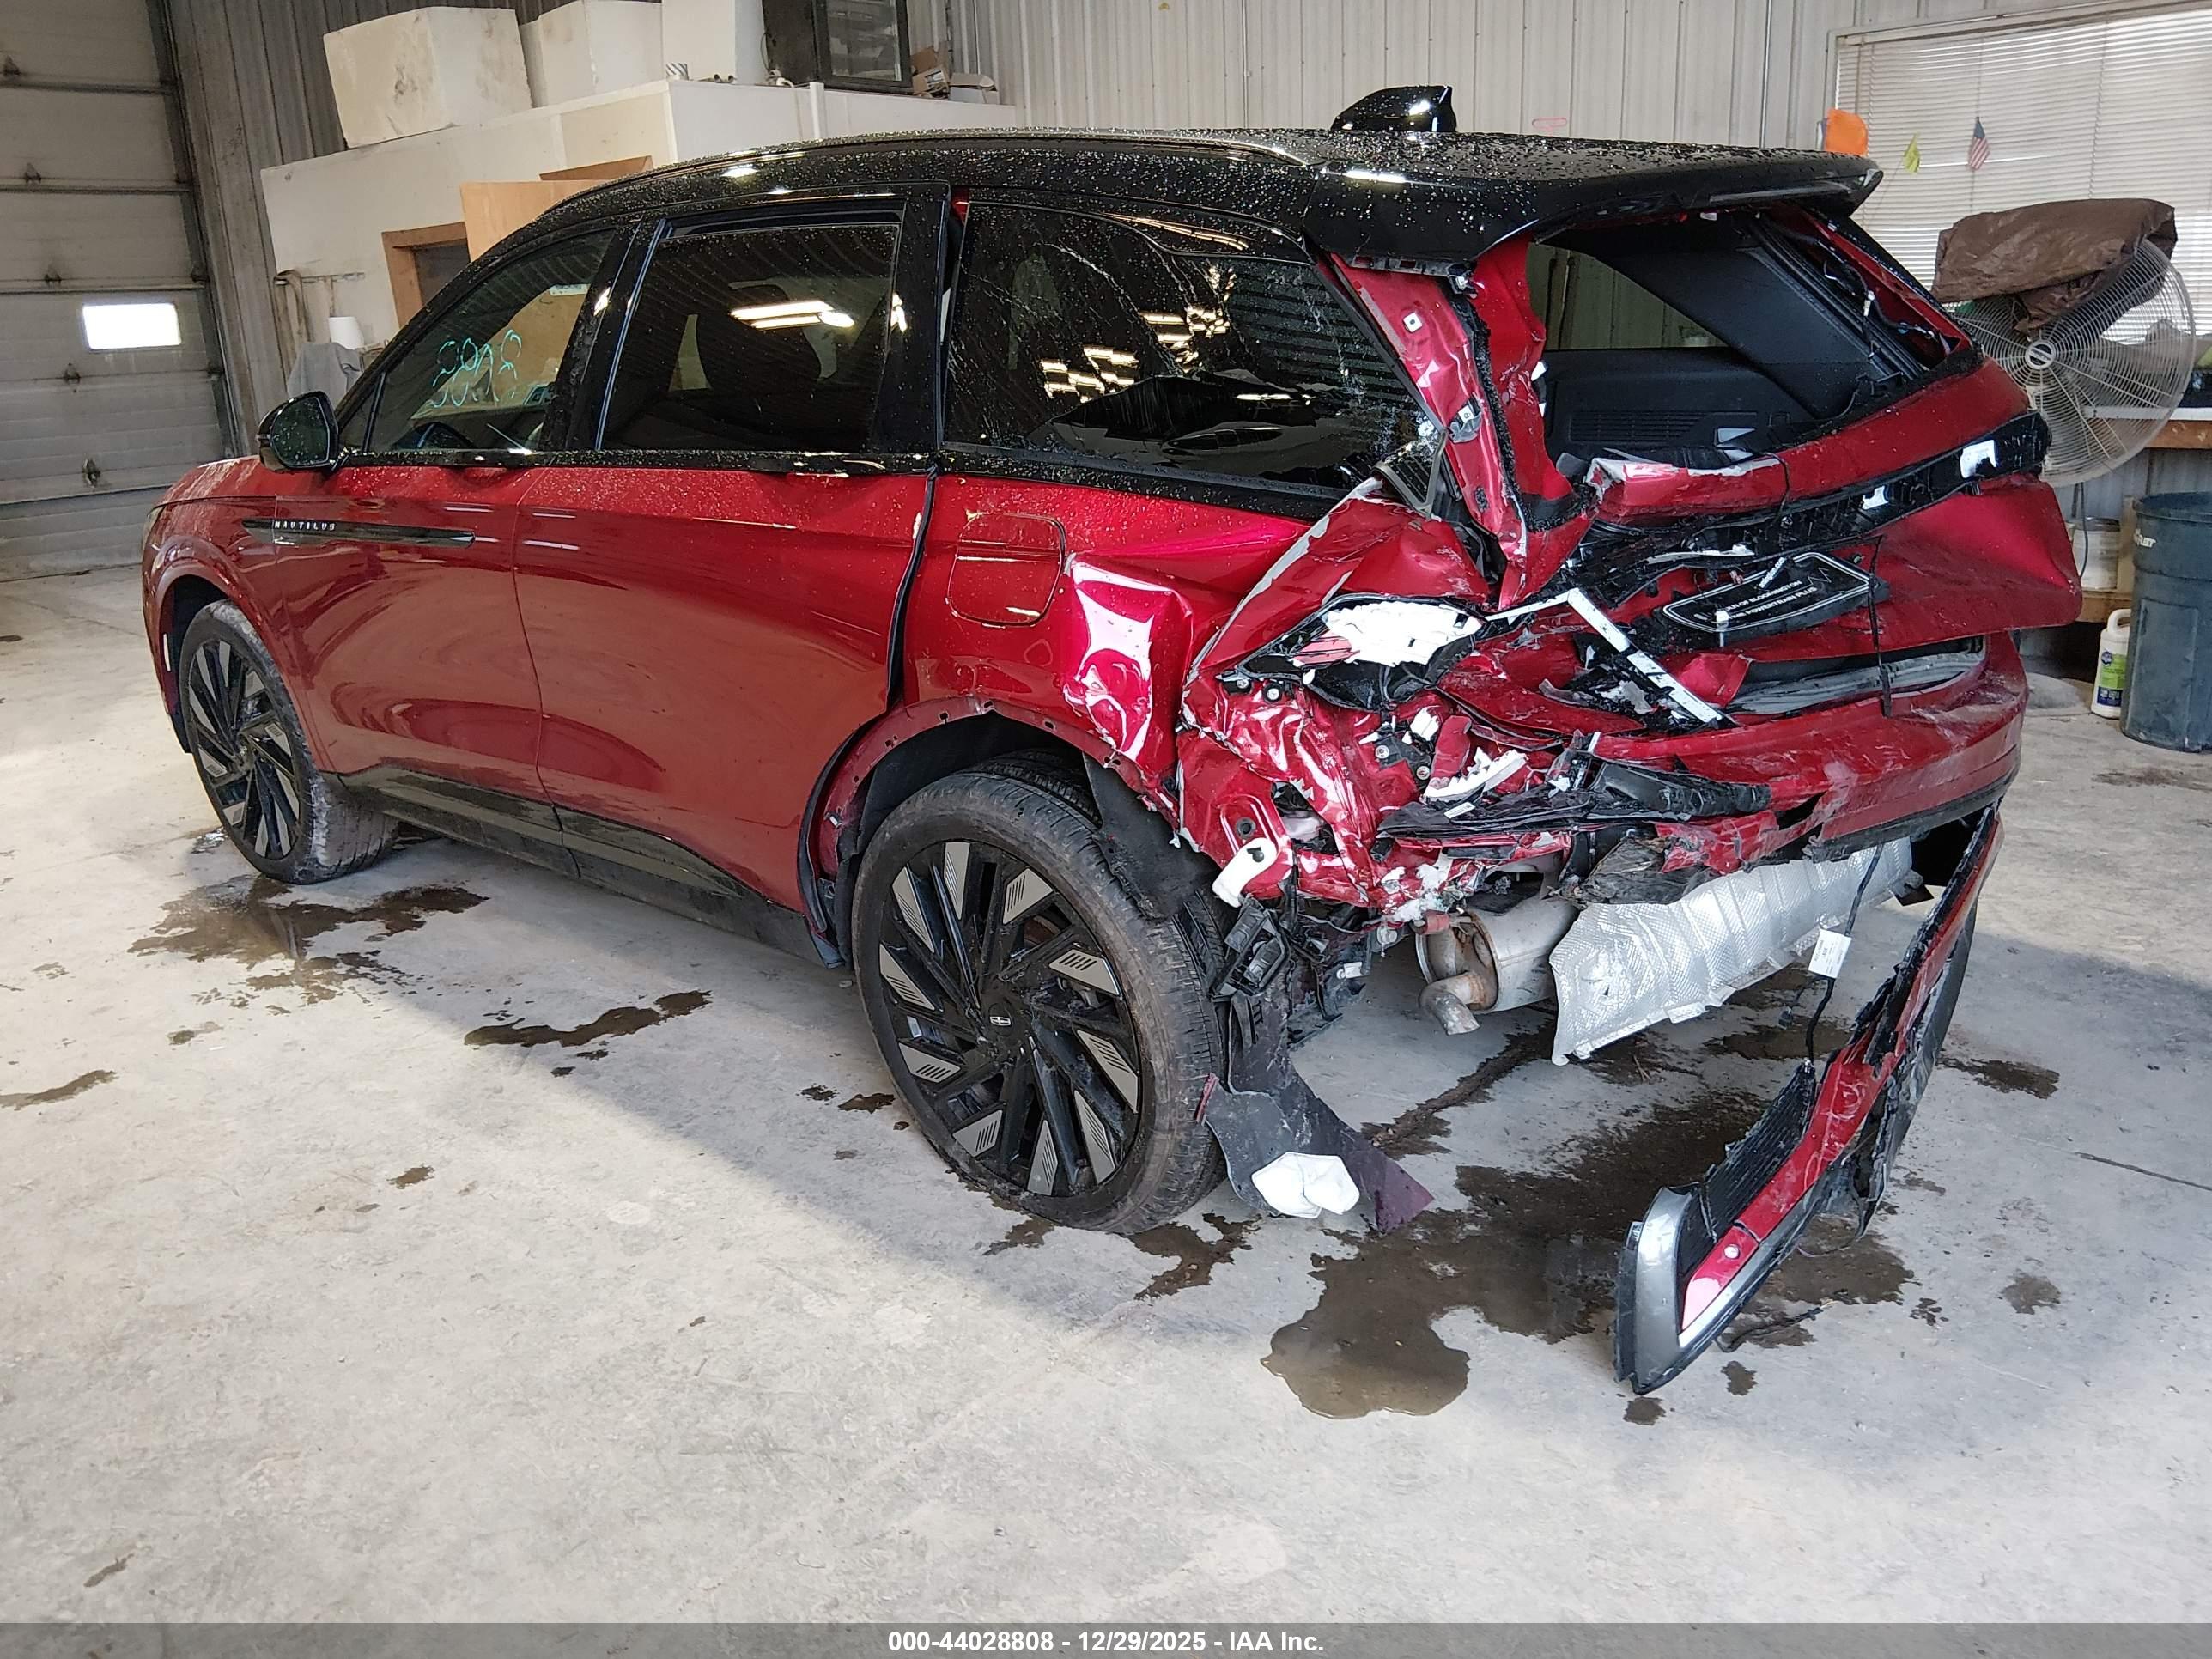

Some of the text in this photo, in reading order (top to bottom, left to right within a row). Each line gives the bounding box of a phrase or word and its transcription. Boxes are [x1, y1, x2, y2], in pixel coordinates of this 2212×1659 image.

[274, 520, 336, 532] NAUTILUS
[1745, 595, 1797, 615] POWERTRAIN
[1795, 586, 1818, 598] PLUS
[1748, 580, 1803, 603] BLOOMINGTON
